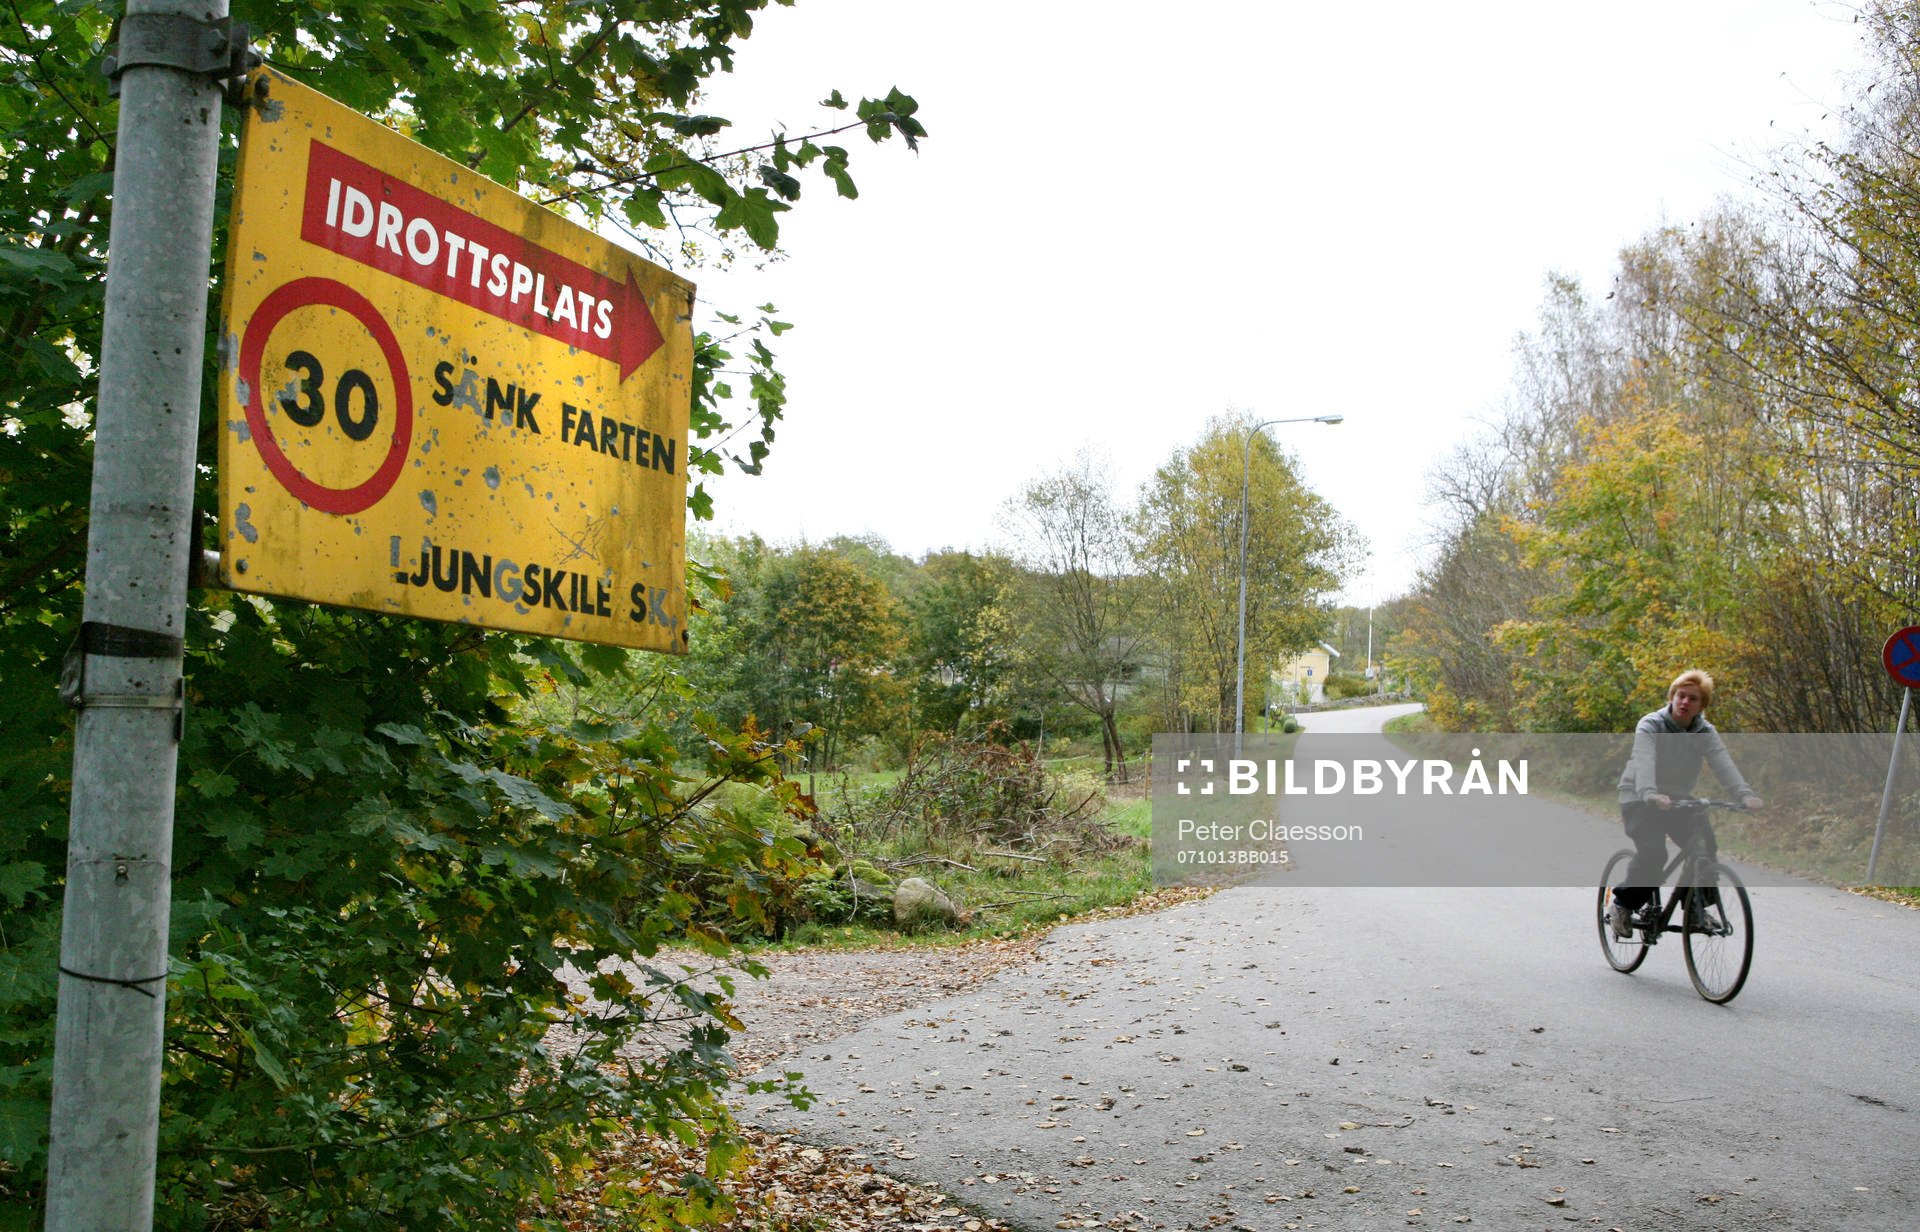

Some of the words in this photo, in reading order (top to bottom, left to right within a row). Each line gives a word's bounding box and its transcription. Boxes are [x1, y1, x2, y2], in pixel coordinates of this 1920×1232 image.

[325, 177, 614, 340] IDROTTSPLATS
[278, 350, 379, 442] 30
[432, 354, 541, 434] SÄNK
[561, 402, 676, 475] FARTEN
[390, 535, 612, 618] LJUNGSKILE
[630, 582, 671, 627] SK
